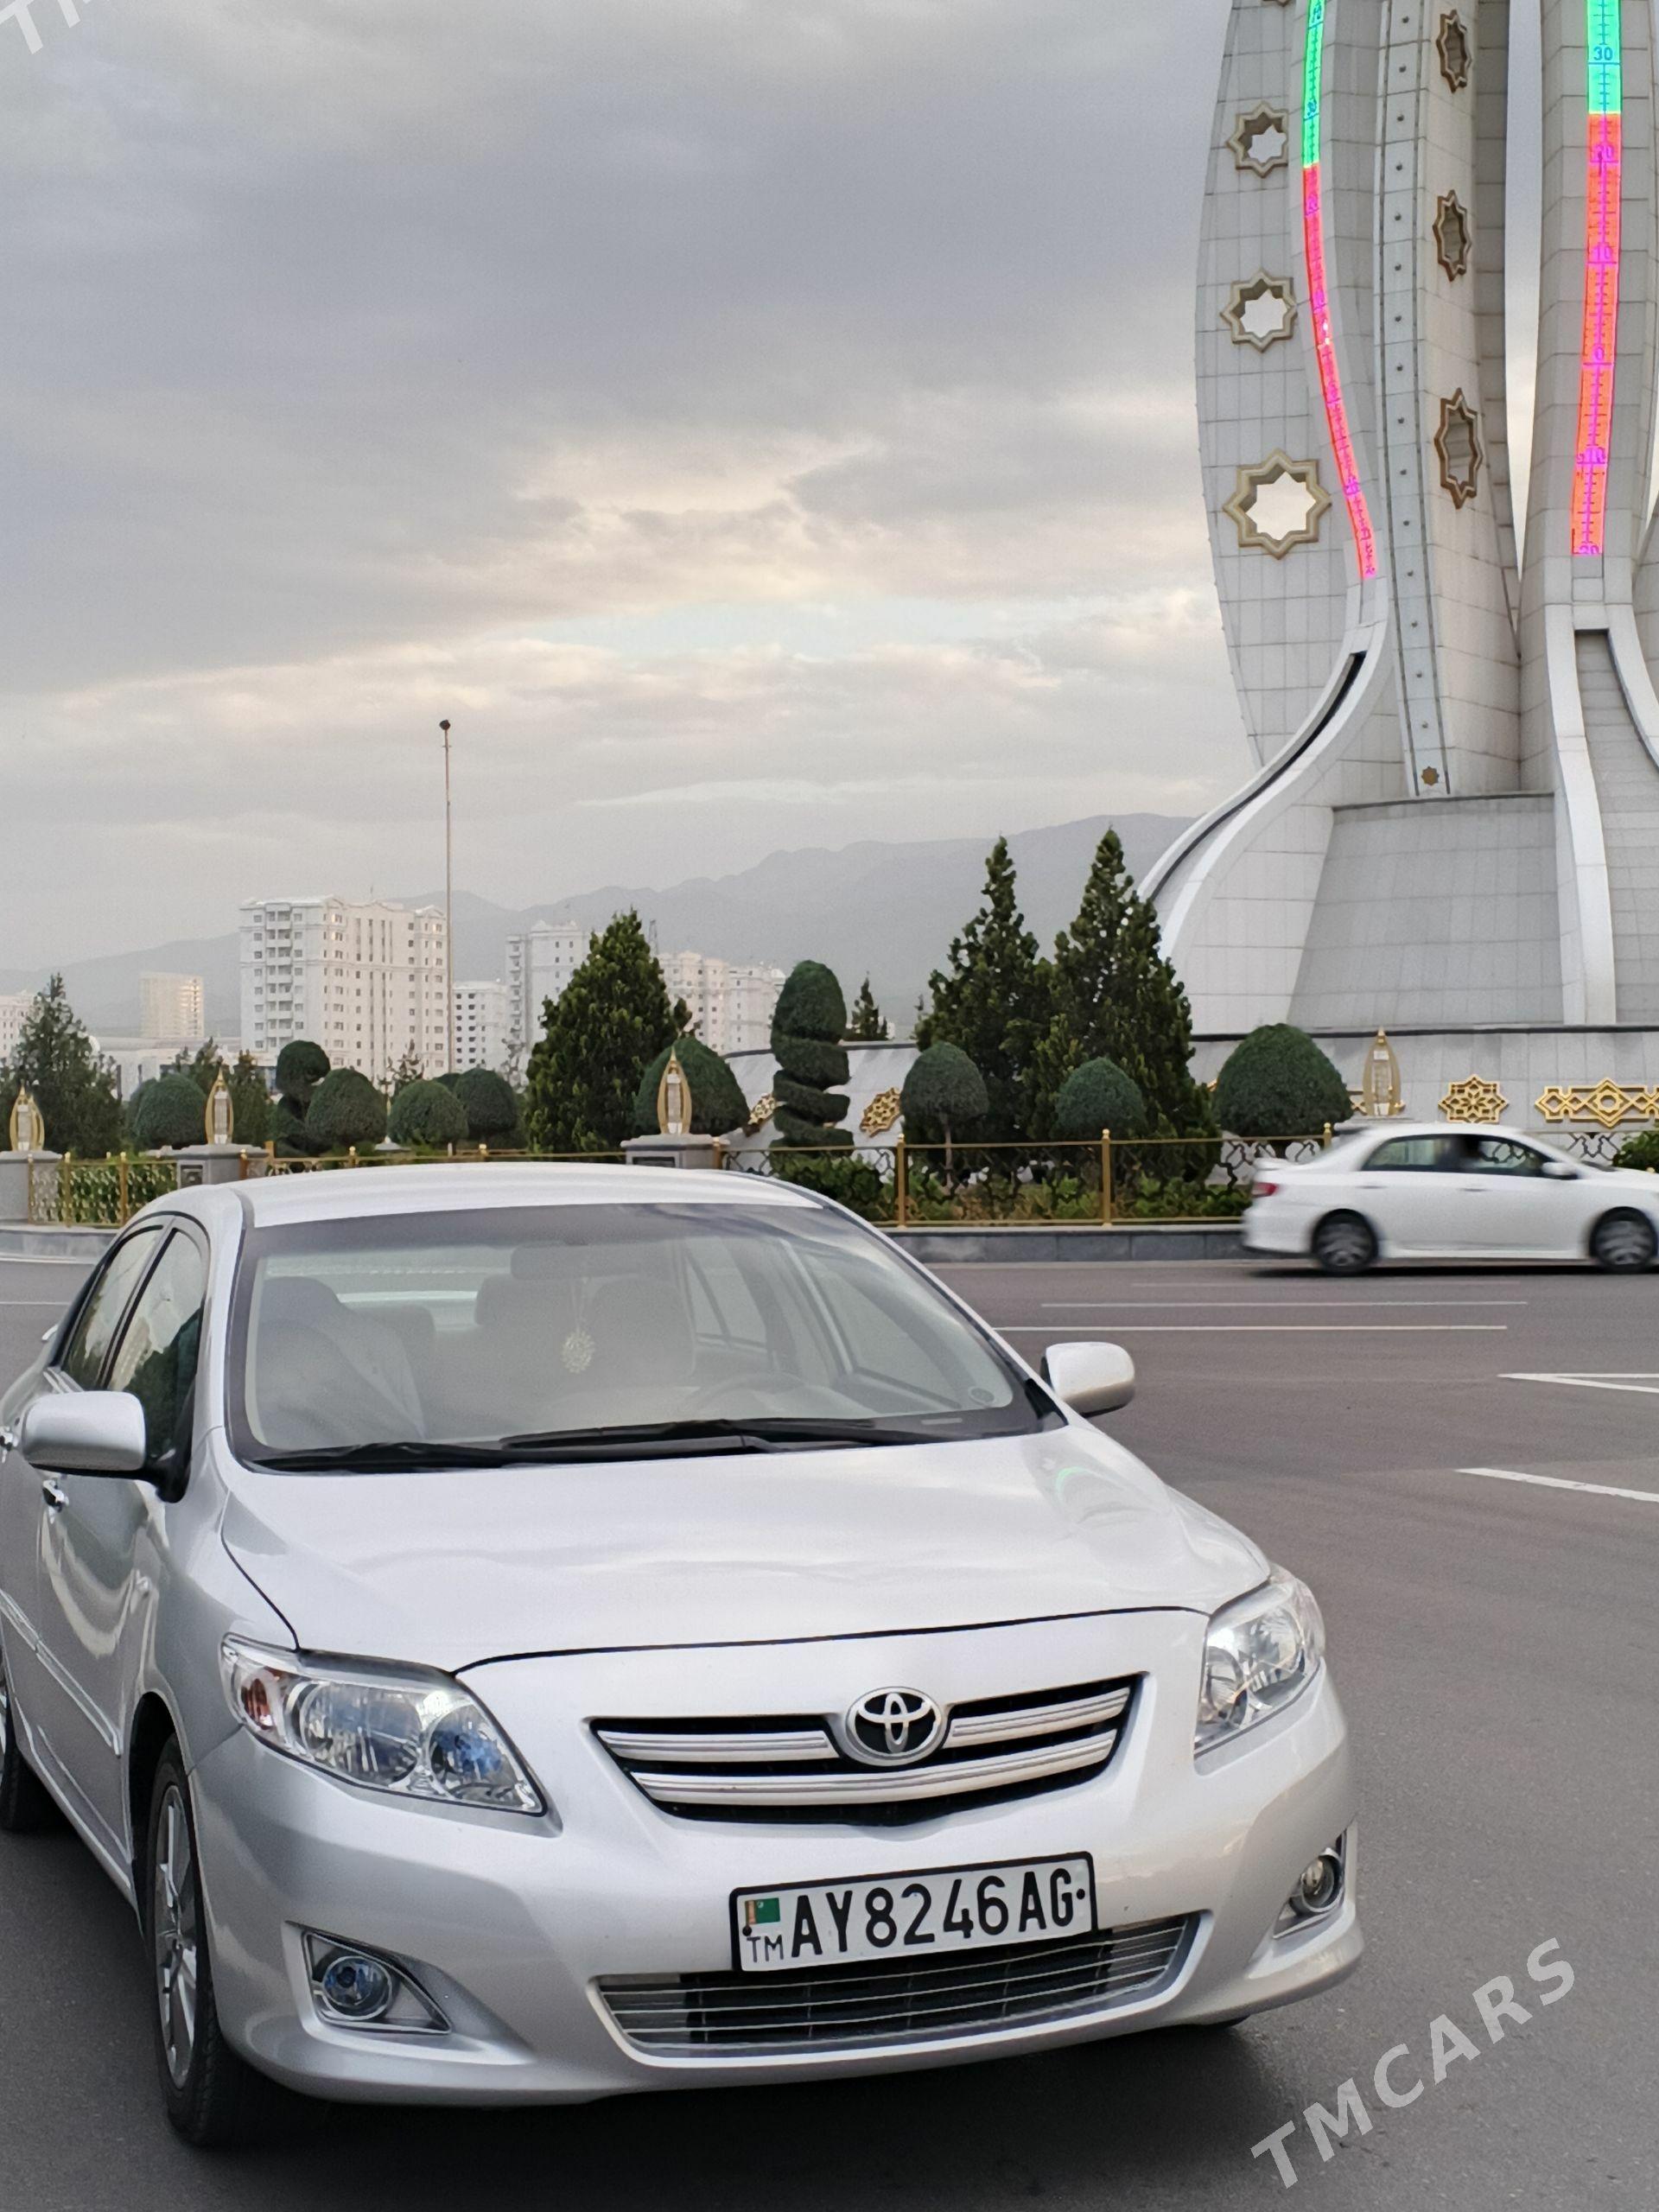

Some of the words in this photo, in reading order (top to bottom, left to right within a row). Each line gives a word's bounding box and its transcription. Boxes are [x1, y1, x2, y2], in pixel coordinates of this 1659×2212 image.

[1593, 46, 1613, 60] 30
[747, 1935, 784, 1962] TM
[791, 1868, 1074, 1958] AY8246AG
